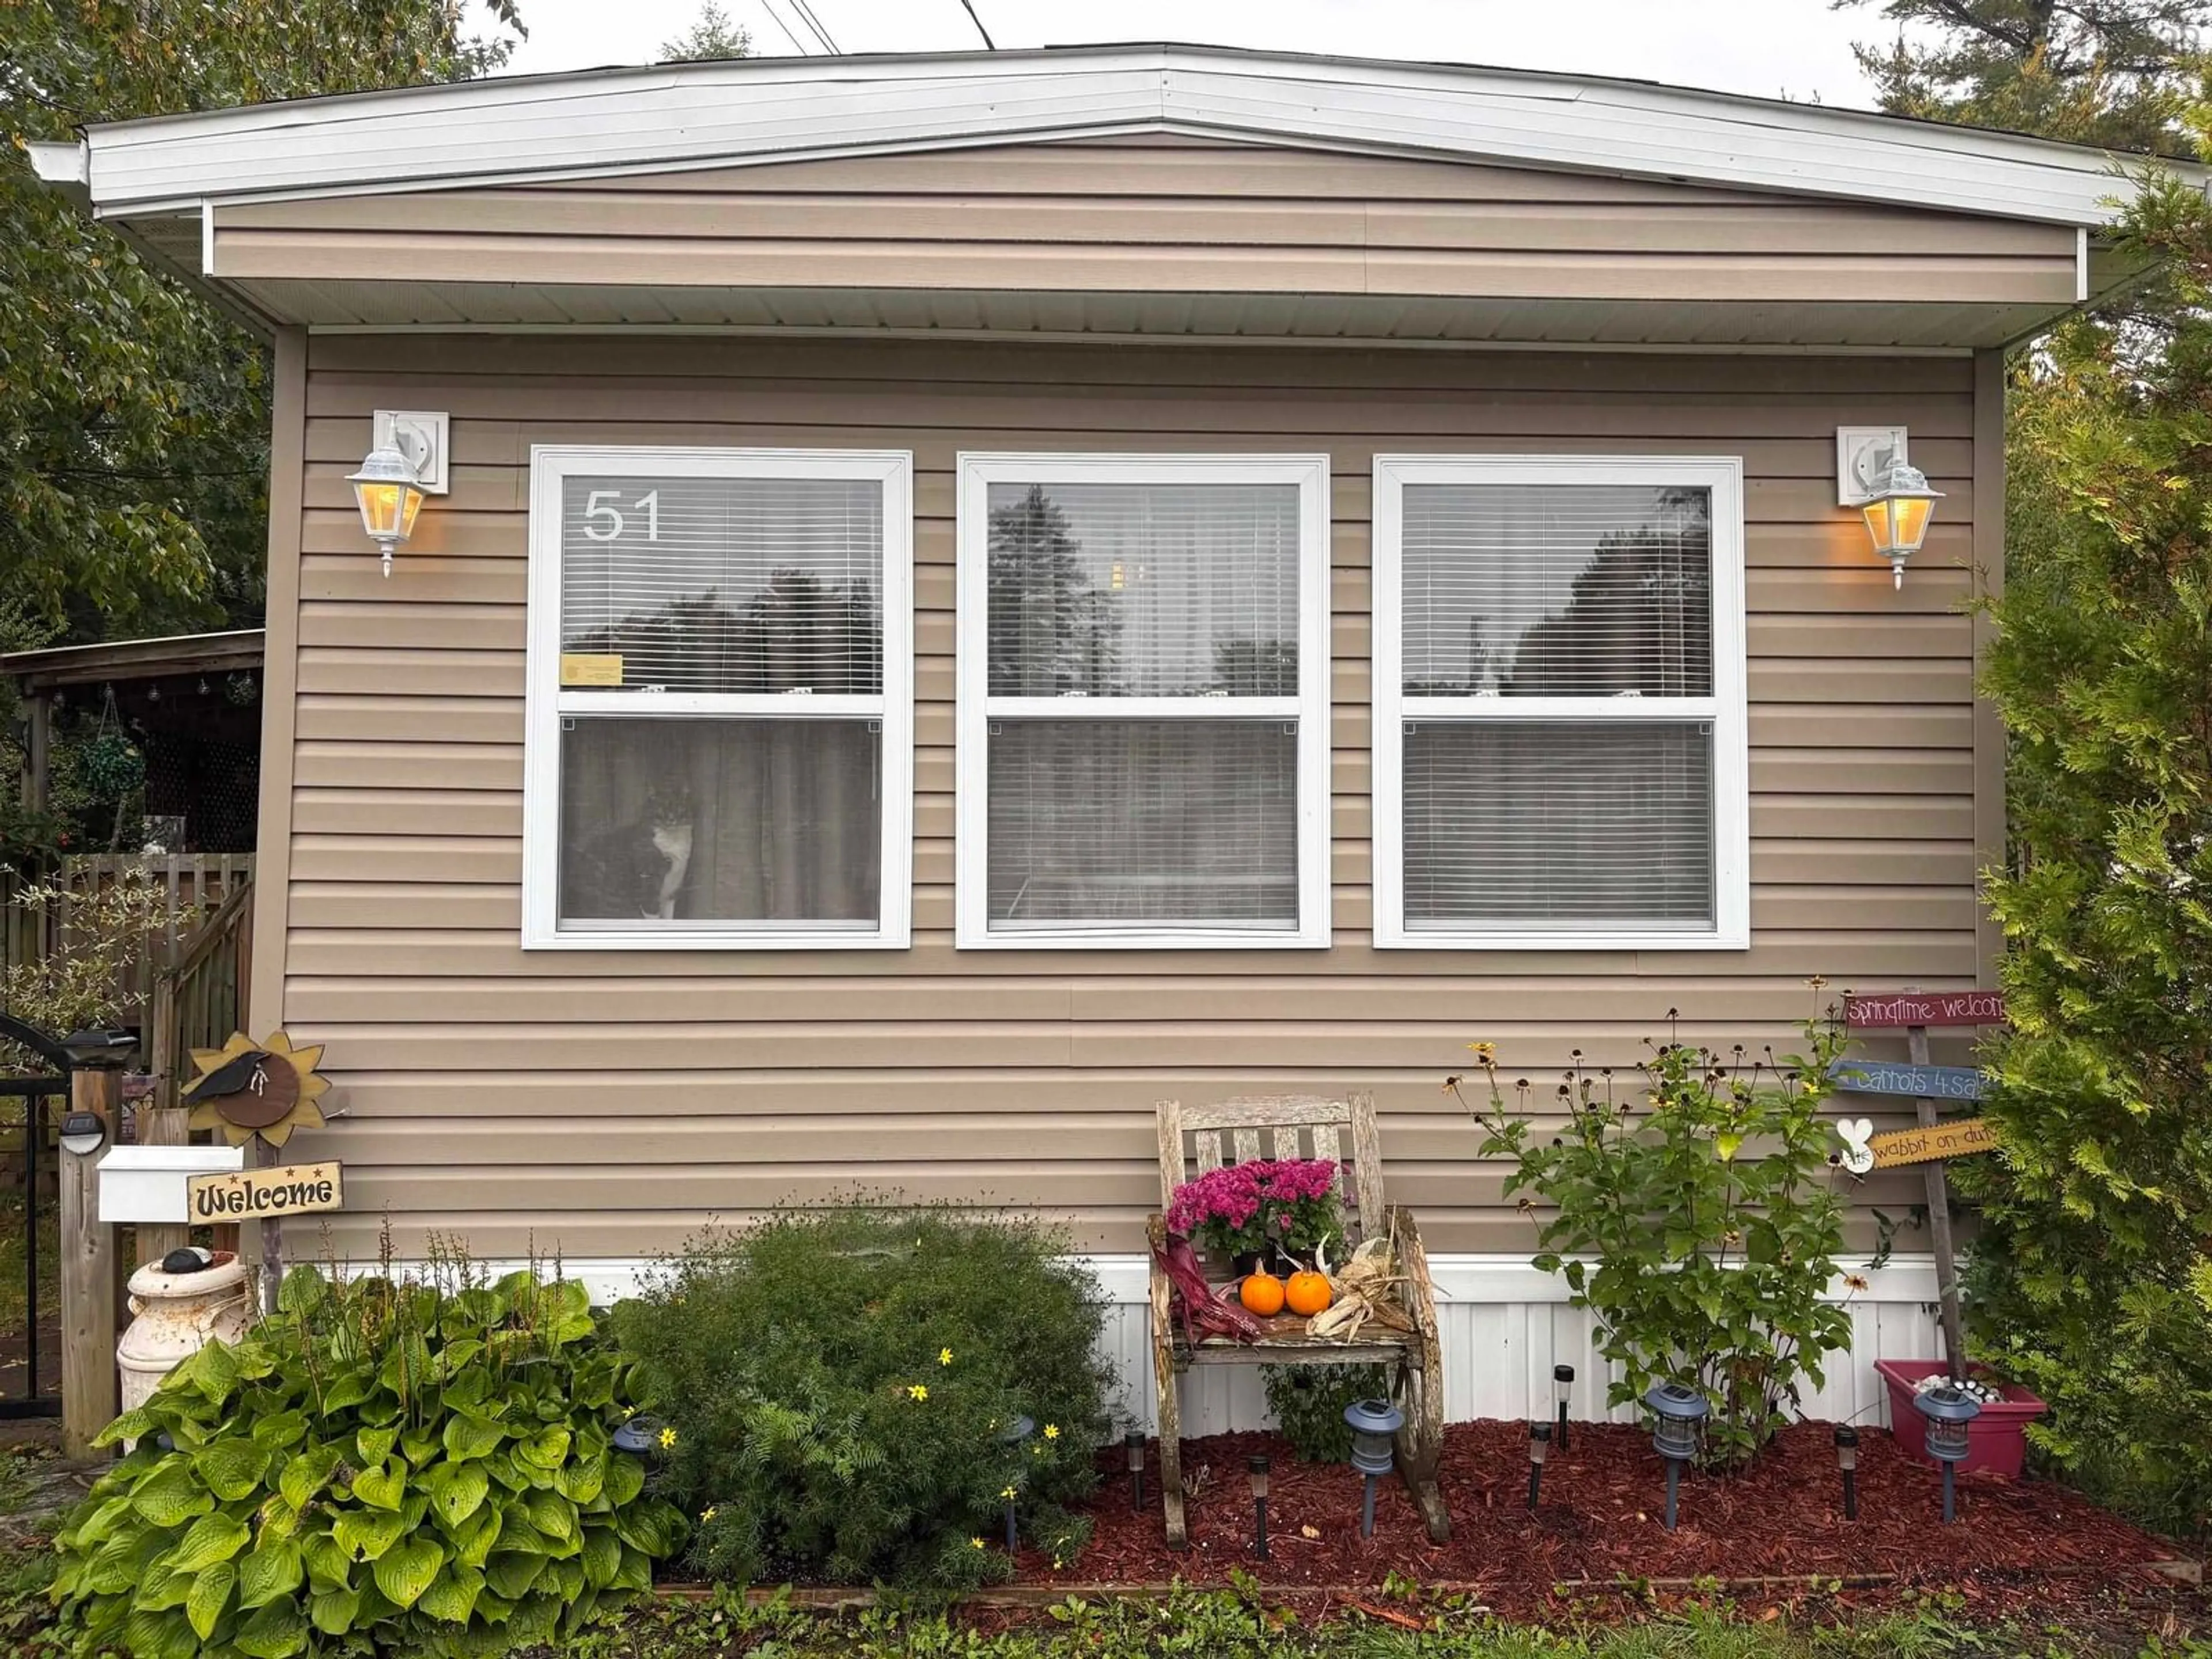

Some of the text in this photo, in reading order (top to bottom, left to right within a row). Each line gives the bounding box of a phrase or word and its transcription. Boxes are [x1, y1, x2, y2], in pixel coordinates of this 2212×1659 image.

[583, 489, 658, 541] 51
[1935, 1069, 1949, 1094] 4
[1873, 1134, 1930, 1159] wabbit
[1937, 1135, 1957, 1149] on
[196, 1180, 332, 1216] Welcome
